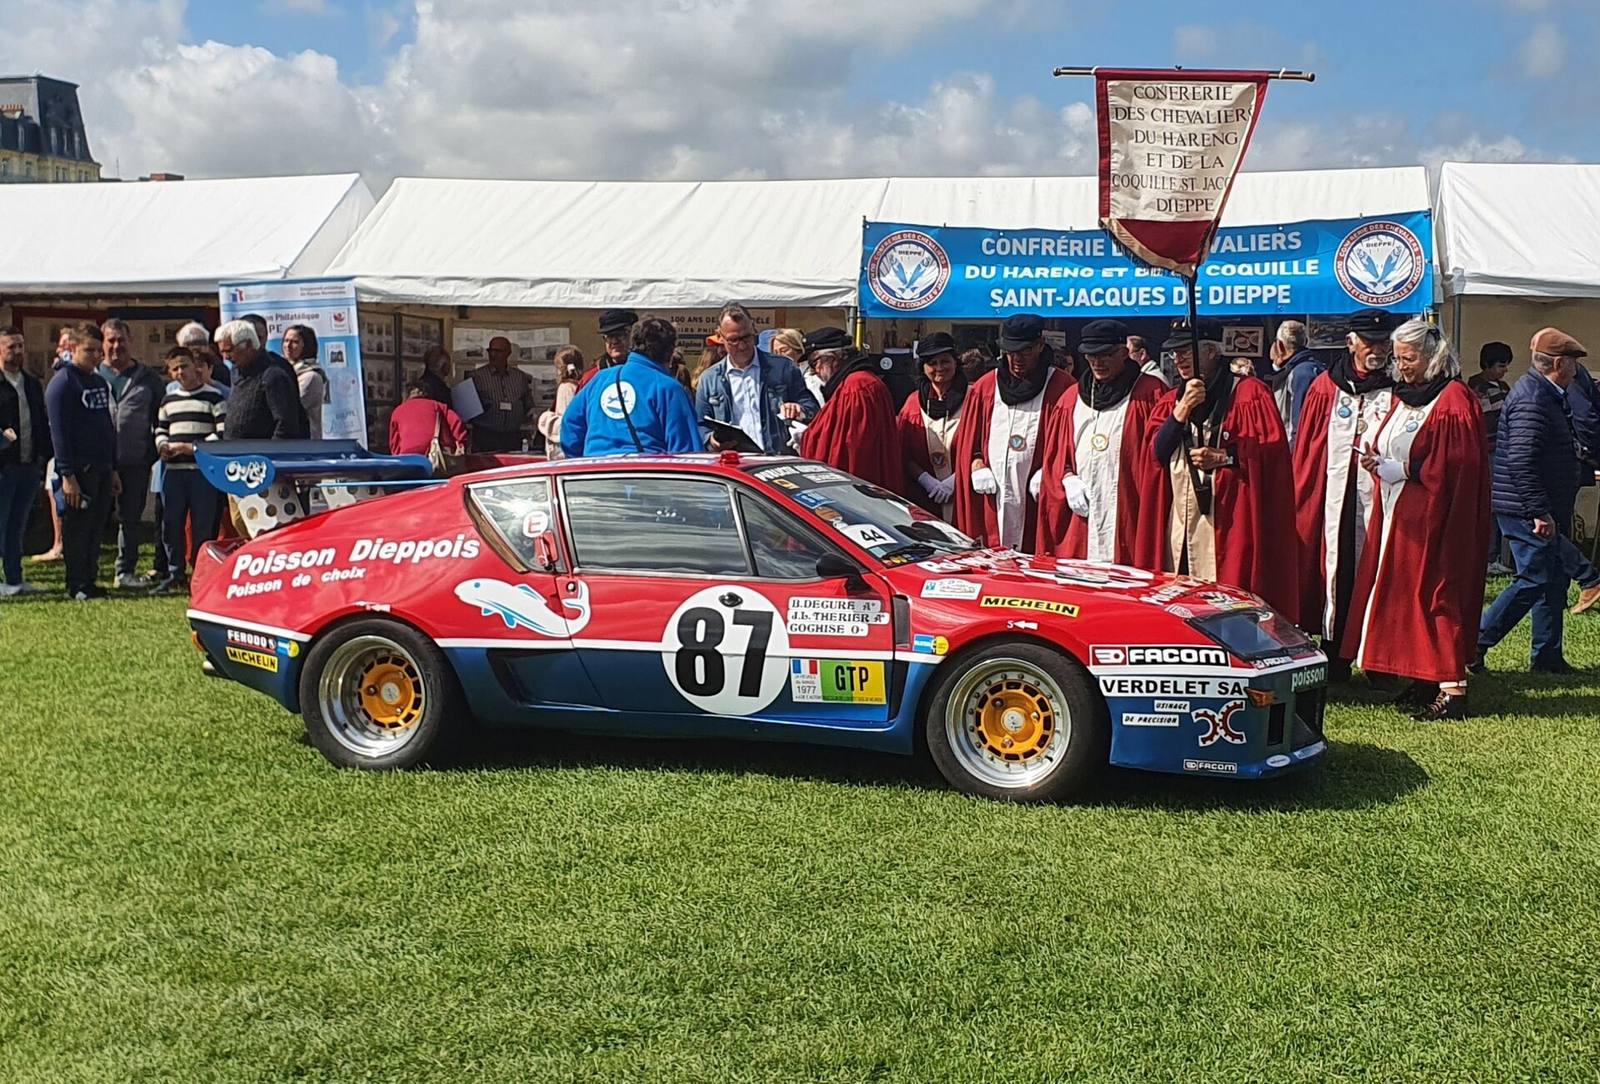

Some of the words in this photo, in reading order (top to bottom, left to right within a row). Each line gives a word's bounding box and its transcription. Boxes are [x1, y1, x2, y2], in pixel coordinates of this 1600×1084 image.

[1134, 86, 1232, 100] CONFRERIE
[1115, 107, 1144, 120] DES
[1134, 130, 1155, 144] DU
[1163, 131, 1238, 147] HARENG
[1147, 153, 1165, 167] ET
[1172, 155, 1192, 169] DE
[1201, 156, 1224, 169] LA
[1112, 174, 1177, 190] COQUILLE
[1181, 177, 1197, 191] ST
[1157, 198, 1214, 212] DIEPPE
[982, 236, 1104, 256] CONFRÉRIE
[1210, 232, 1301, 253] VALIERS
[965, 265, 991, 279] DU
[1004, 267, 1092, 278] HARENG
[1101, 267, 1128, 278] ET
[1206, 260, 1319, 276] COQUILLE
[990, 286, 1165, 307] SAINT-JACQUES
[1209, 285, 1290, 305] DIEPPE
[860, 530, 886, 542] 44
[232, 548, 336, 580] Poisson
[349, 533, 480, 564] Dieppois
[227, 579, 282, 600] Poisson
[292, 573, 312, 588] de
[321, 567, 367, 583] choix
[983, 598, 1076, 615] MICHELIN
[812, 612, 870, 623] THERIER
[227, 629, 268, 648] FERODO
[228, 648, 277, 670] MICHELIN
[675, 606, 774, 698] 87
[1129, 649, 1227, 665] FACOM
[834, 665, 870, 692] GTP
[1291, 667, 1325, 692] poisson
[797, 685, 817, 694] 1977
[1102, 680, 1210, 694] VERDELET
[1218, 681, 1244, 695] SA
[1155, 701, 1188, 711] USINAGE
[1123, 715, 1134, 723] DE
[1136, 715, 1177, 725] PRECISION
[1198, 762, 1236, 771] FACOM
